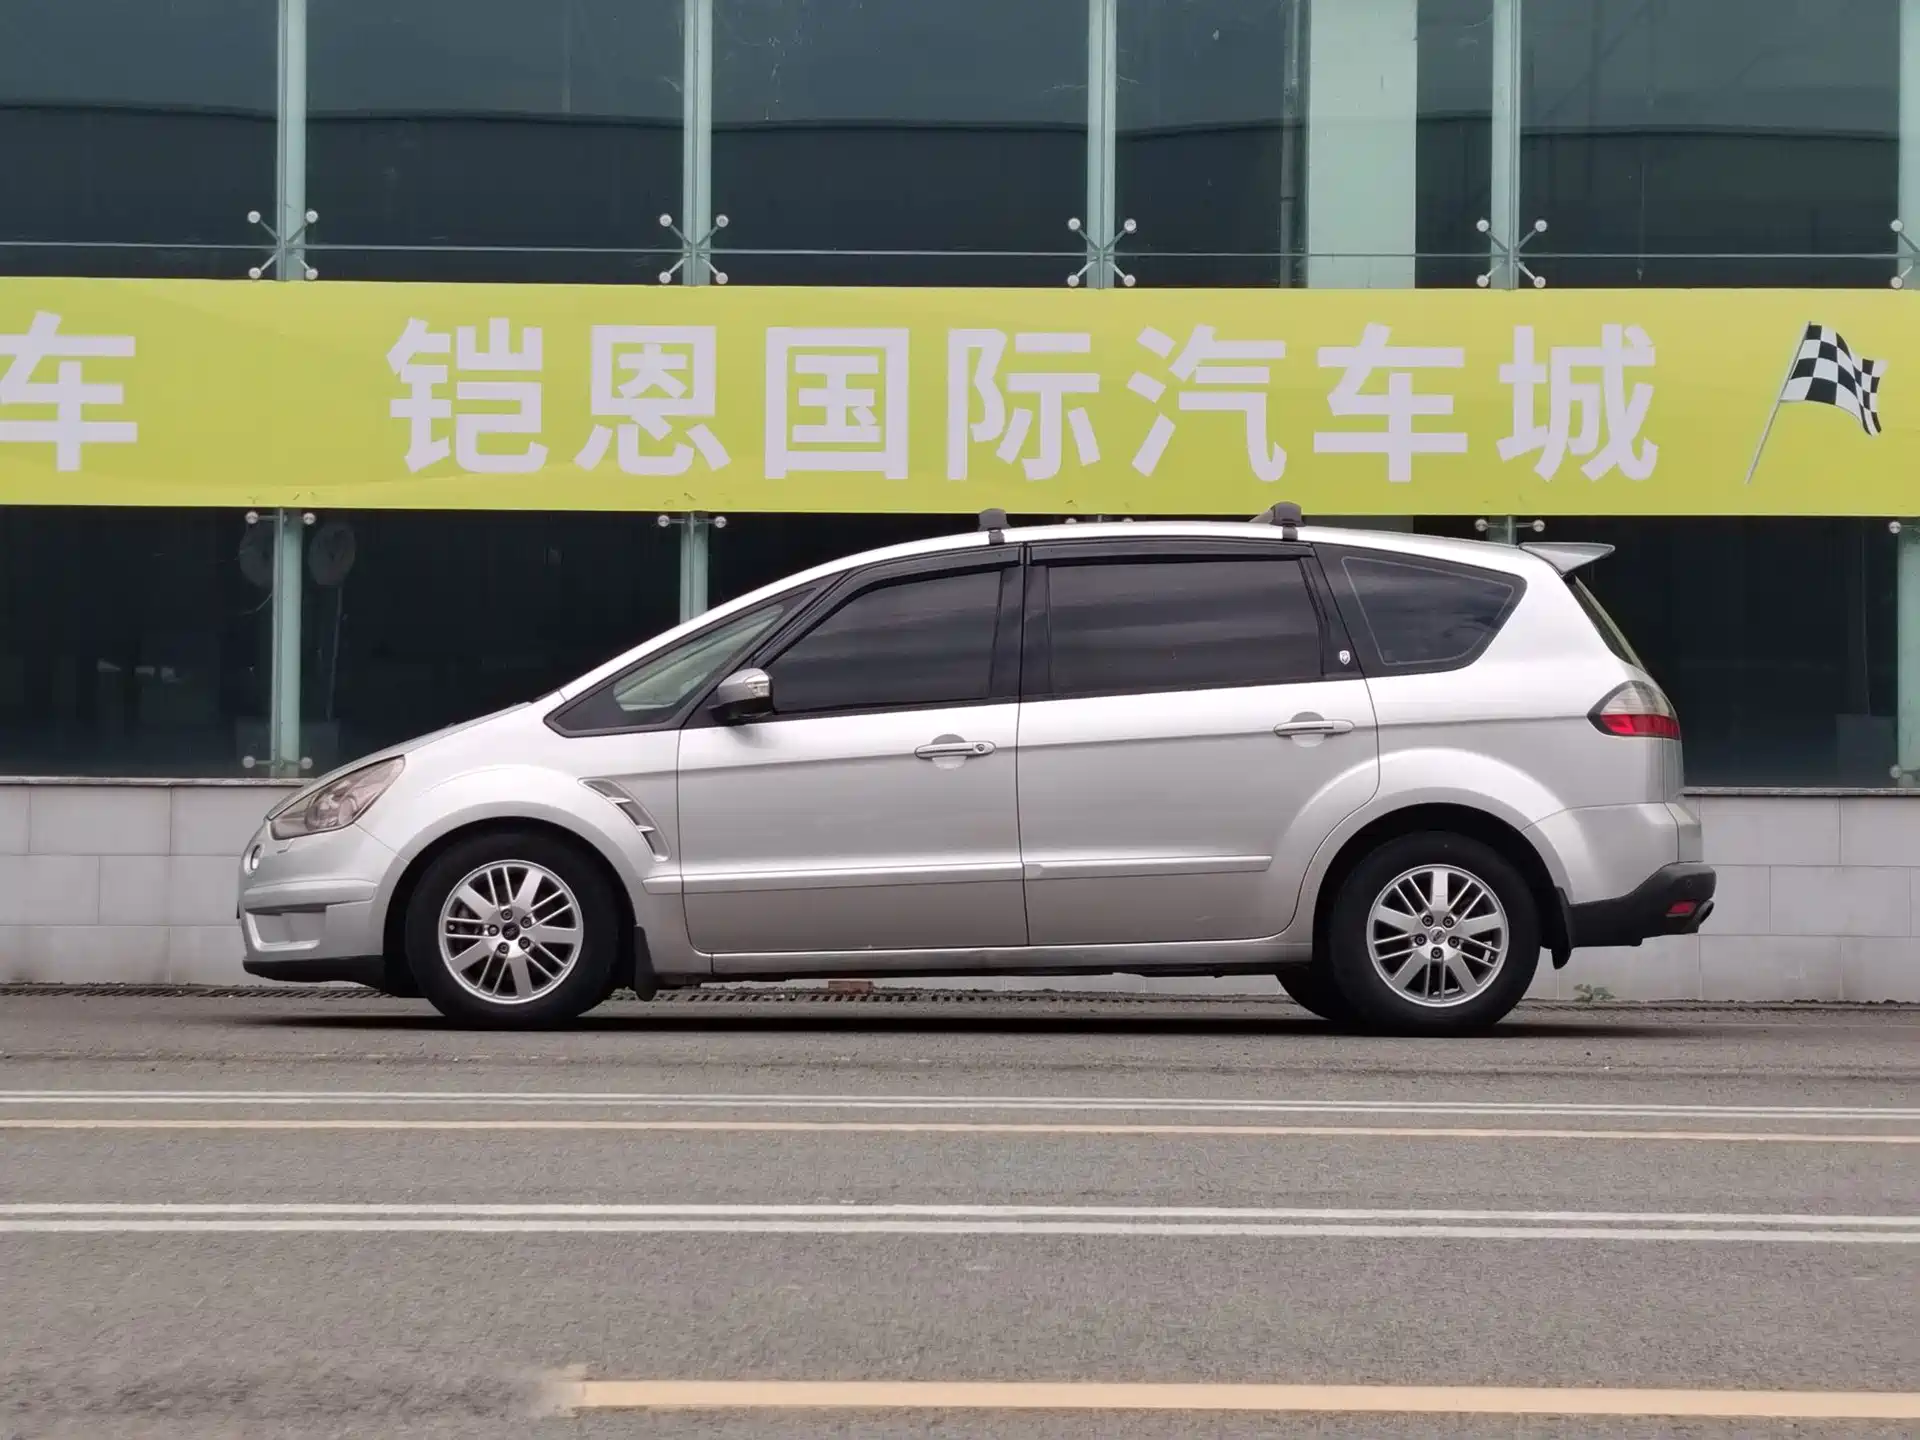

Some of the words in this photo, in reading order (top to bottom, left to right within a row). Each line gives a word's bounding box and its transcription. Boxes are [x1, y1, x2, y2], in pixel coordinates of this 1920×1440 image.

[0, 311, 138, 472] 车
[386, 317, 1659, 482] 铠恩国际汽车城
